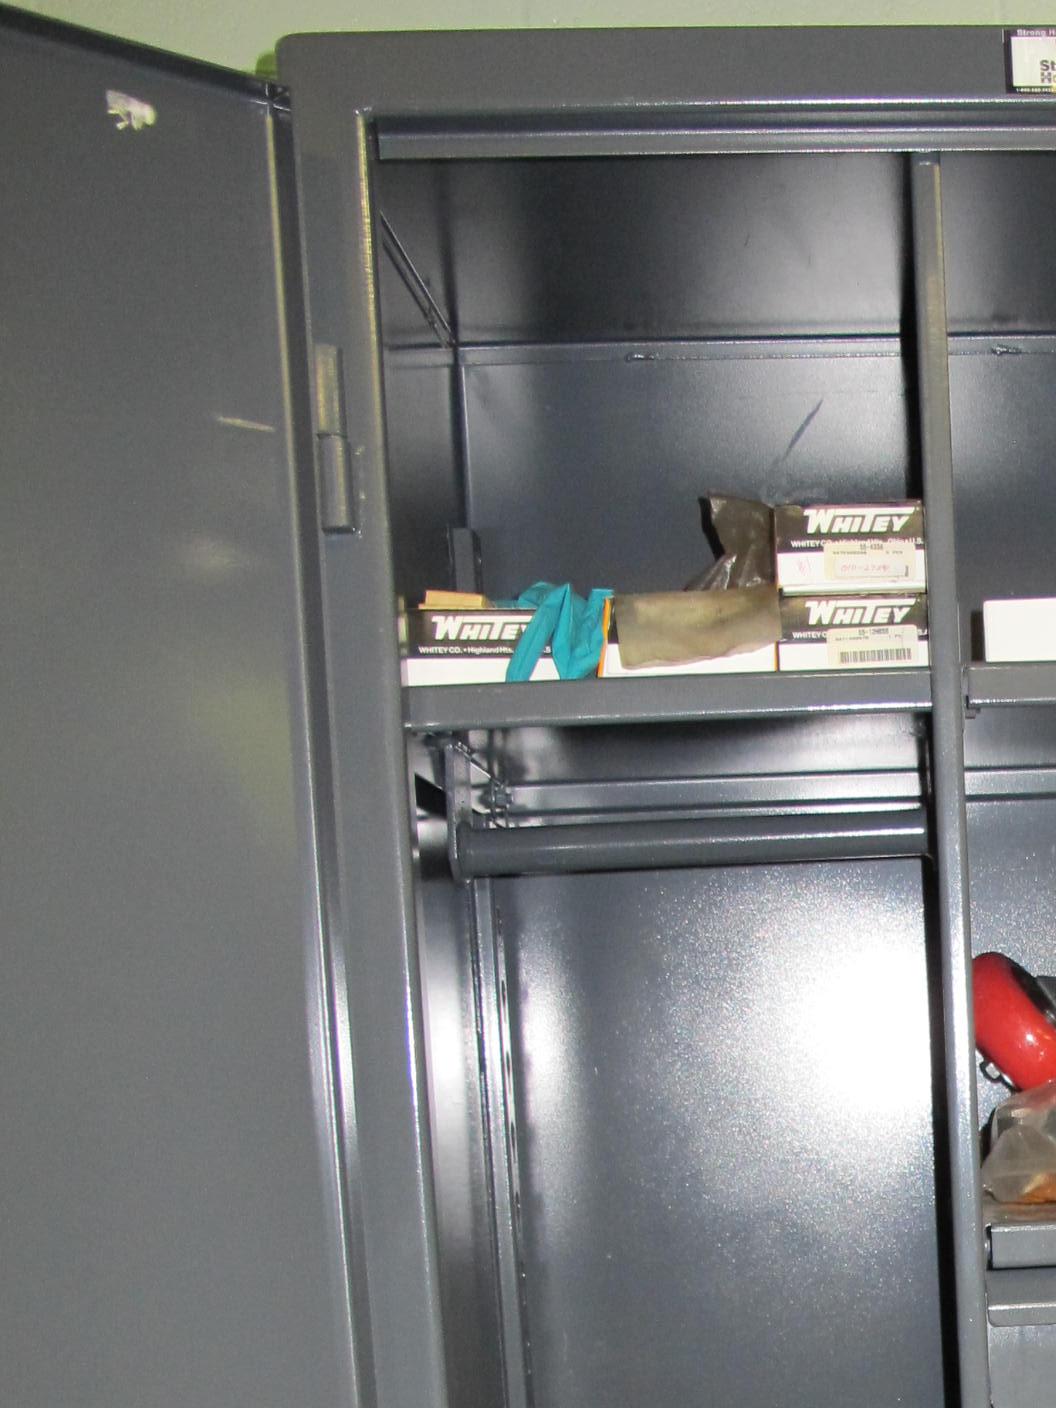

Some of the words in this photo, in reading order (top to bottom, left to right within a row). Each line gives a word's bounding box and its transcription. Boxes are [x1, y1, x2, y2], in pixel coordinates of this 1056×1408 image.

[803, 506, 916, 534] WHITEY
[790, 540, 821, 549] WHITEY
[804, 598, 917, 625] WHITEY
[792, 631, 823, 640] WHITEY
[418, 646, 448, 654] WHITEY
